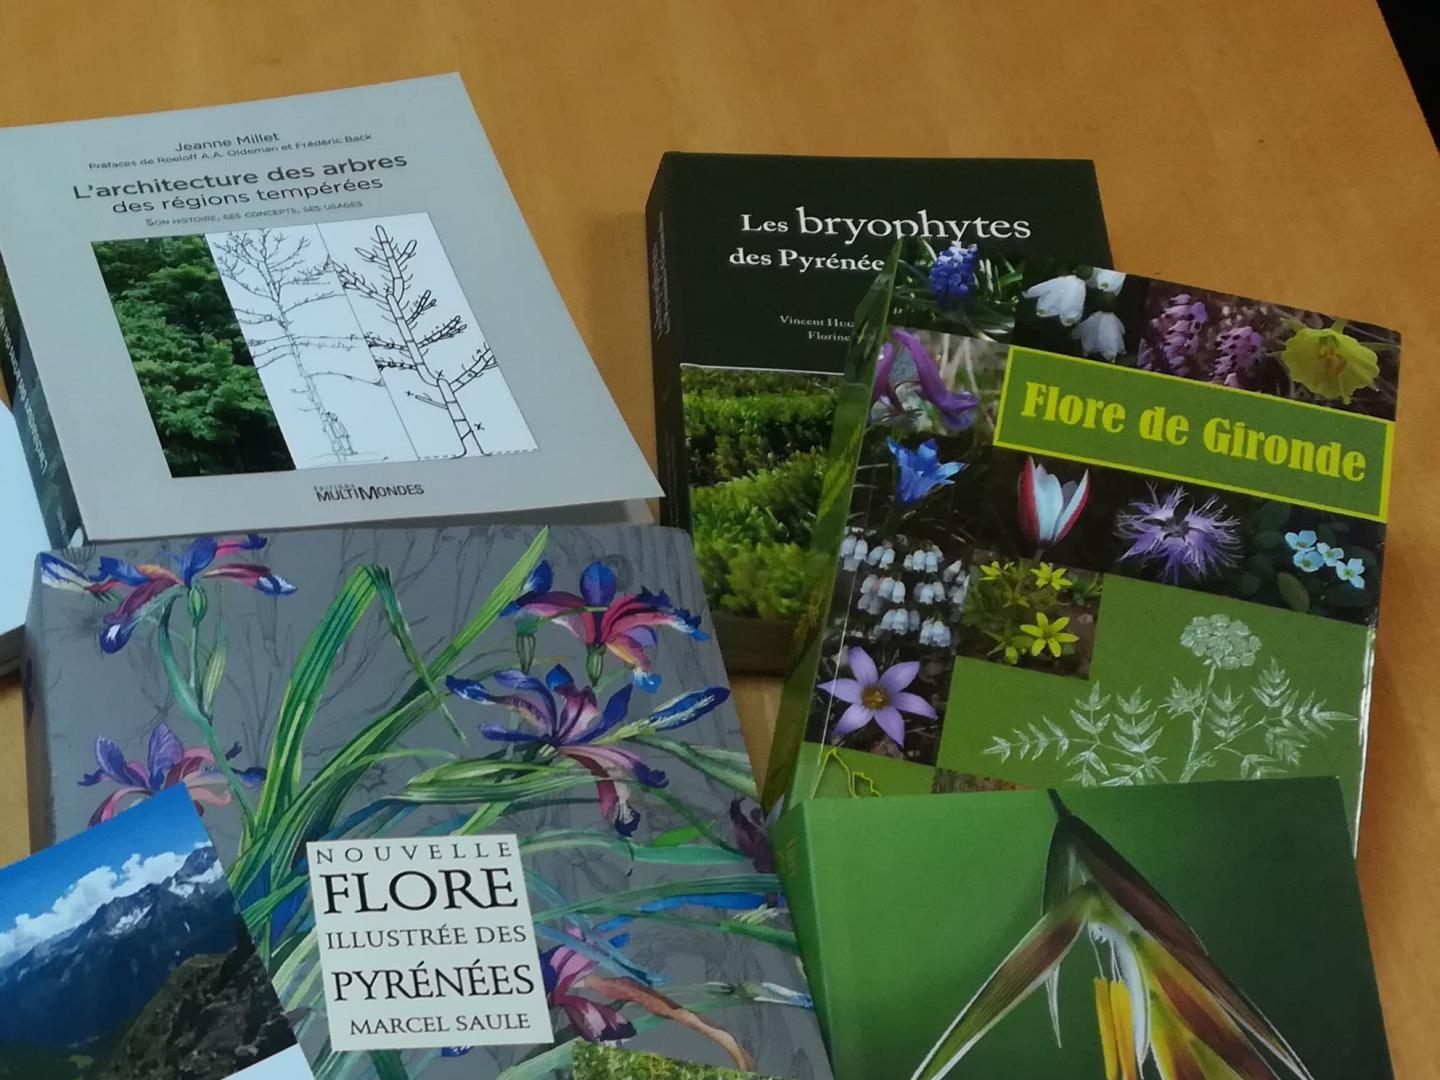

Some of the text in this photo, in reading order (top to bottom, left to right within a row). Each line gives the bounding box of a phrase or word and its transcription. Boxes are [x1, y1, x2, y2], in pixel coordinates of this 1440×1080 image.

[175, 132, 280, 152] Jeanne Millet
[345, 132, 373, 143] Back
[73, 154, 408, 199] L'architecture des arbres
[112, 177, 383, 213] des régions tempérées
[740, 206, 1032, 245] Les bryophytes
[729, 248, 885, 272] des Pyrénée
[780, 315, 824, 326] Vincent
[808, 331, 852, 341] Florine
[1020, 381, 1367, 482] Flore de Gironde
[316, 842, 512, 864] NOUVELLE
[320, 868, 519, 914] FLORE
[327, 924, 527, 949] ILLUSTRÉE DES
[331, 959, 535, 1002] PYRÉNÉES
[350, 1013, 531, 1035] MARCEL SAULE
